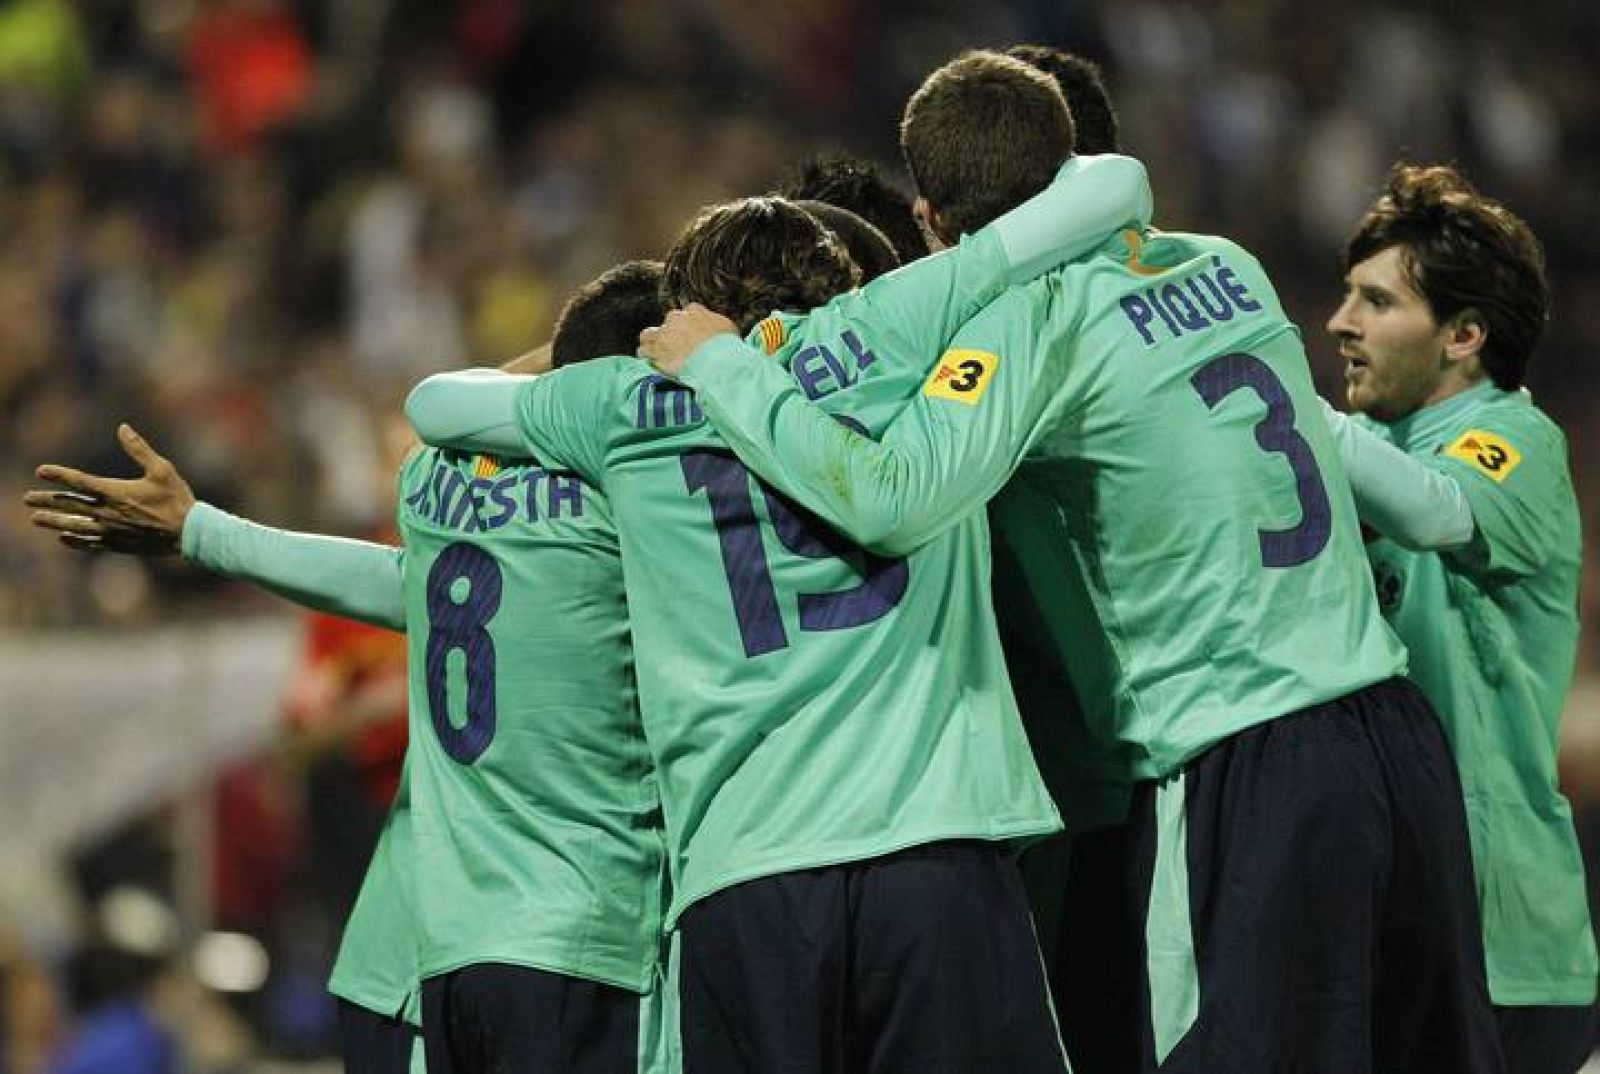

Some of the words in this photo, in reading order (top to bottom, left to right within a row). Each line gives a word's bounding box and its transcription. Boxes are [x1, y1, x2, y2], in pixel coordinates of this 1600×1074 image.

[1119, 255, 1263, 345] PIQUÉ
[1190, 353, 1332, 567] 3
[426, 541, 503, 765] 8
